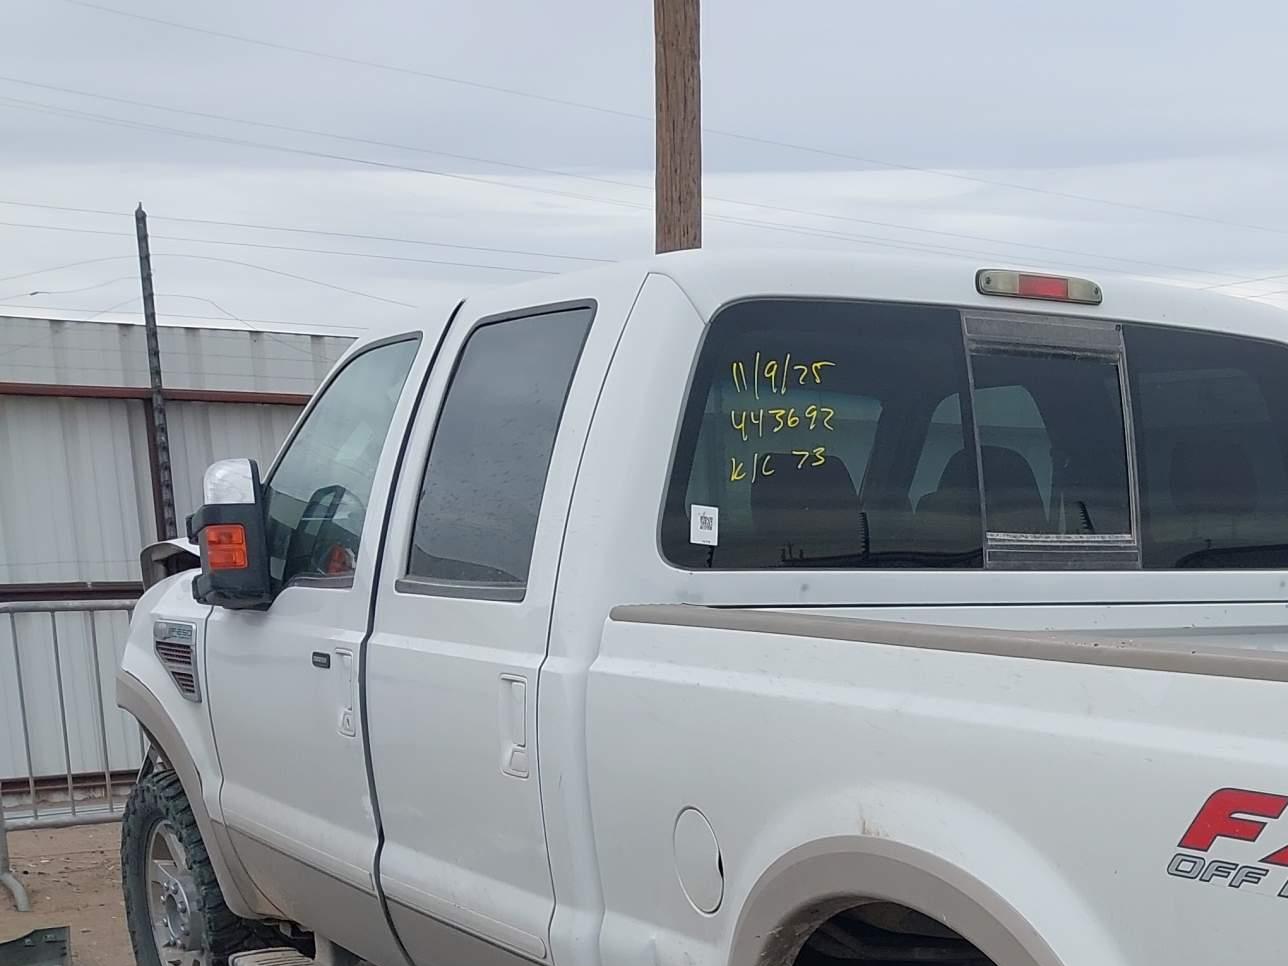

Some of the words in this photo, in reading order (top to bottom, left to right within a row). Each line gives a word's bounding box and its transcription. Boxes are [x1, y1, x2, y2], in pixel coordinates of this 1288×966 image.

[731, 350, 836, 400] 11/9/25
[730, 405, 834, 441] 443692
[792, 447, 826, 469] 73
[1166, 853, 1270, 888] OFF
